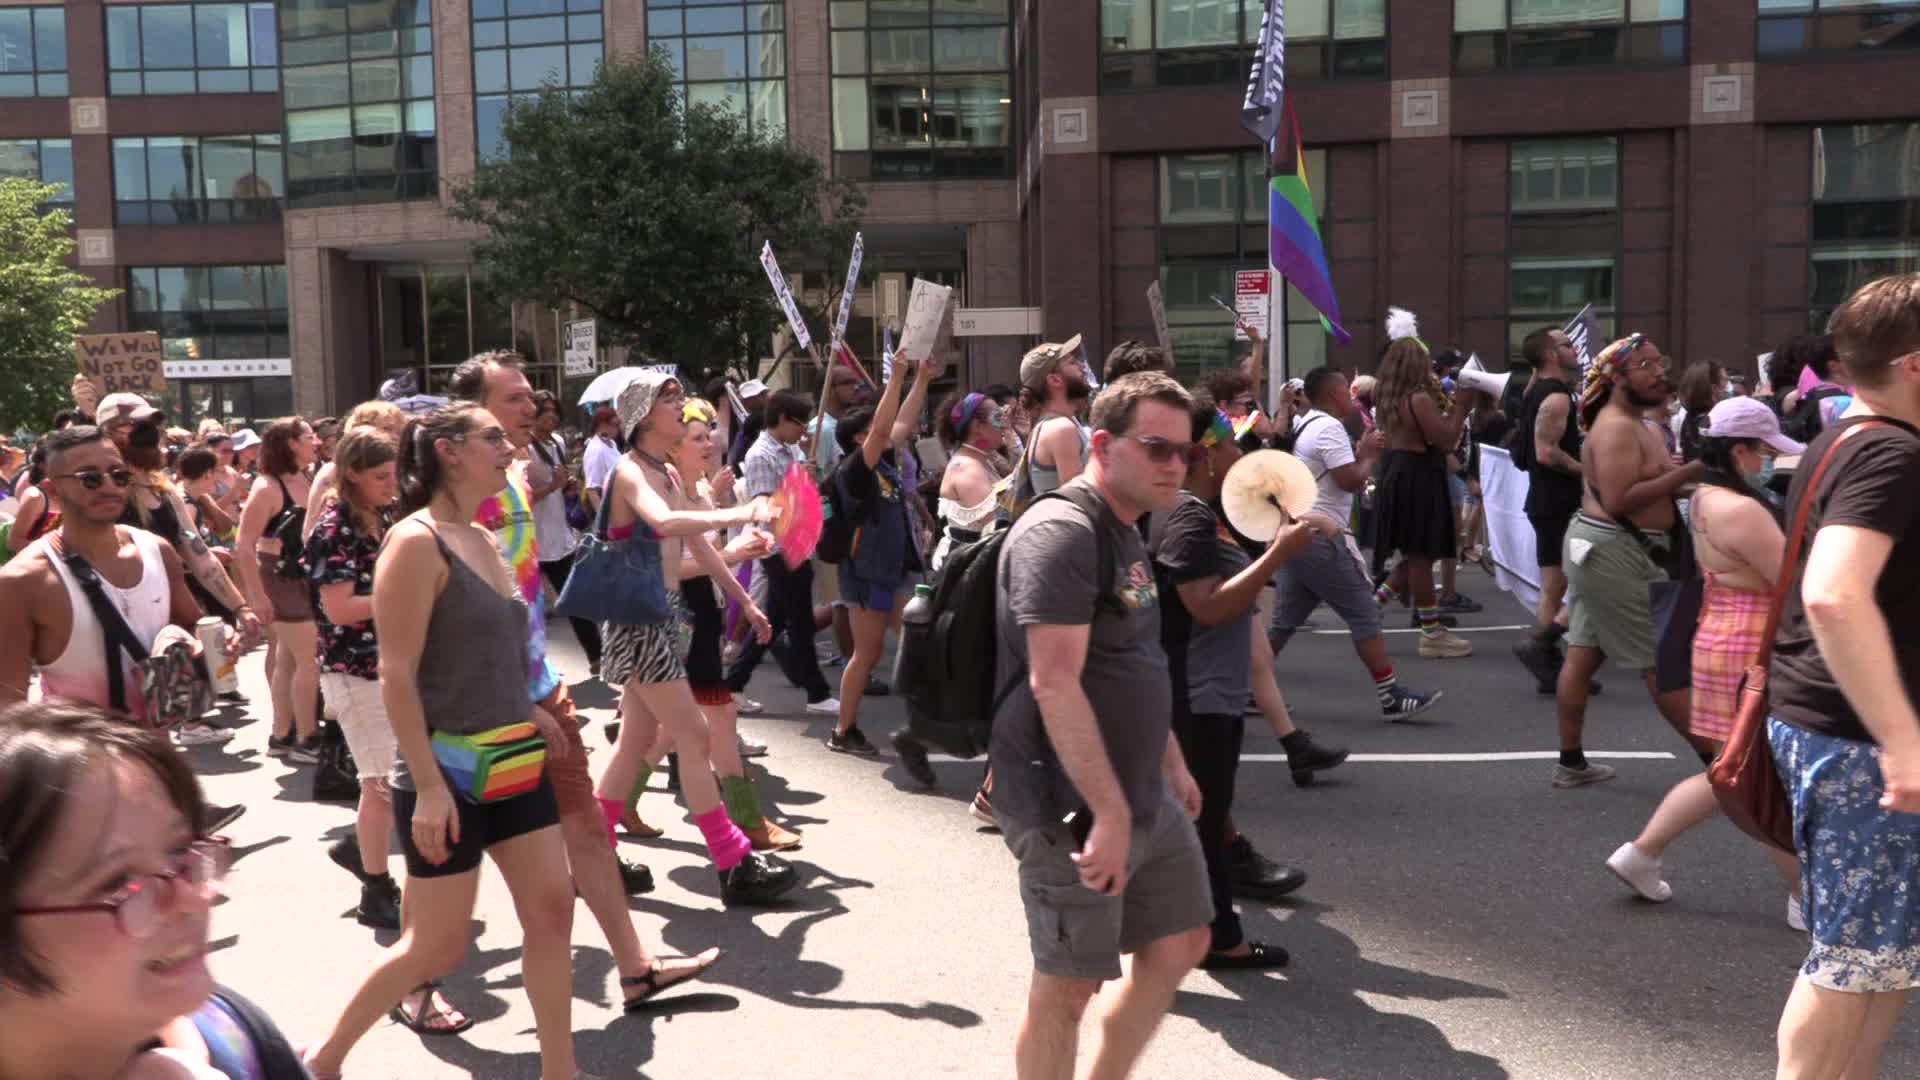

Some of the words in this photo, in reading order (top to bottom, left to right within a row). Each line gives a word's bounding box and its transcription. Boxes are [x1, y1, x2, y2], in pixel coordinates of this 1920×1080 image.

[84, 358, 124, 375] NOT
[131, 356, 157, 373] GO
[104, 375, 152, 391] BACK
